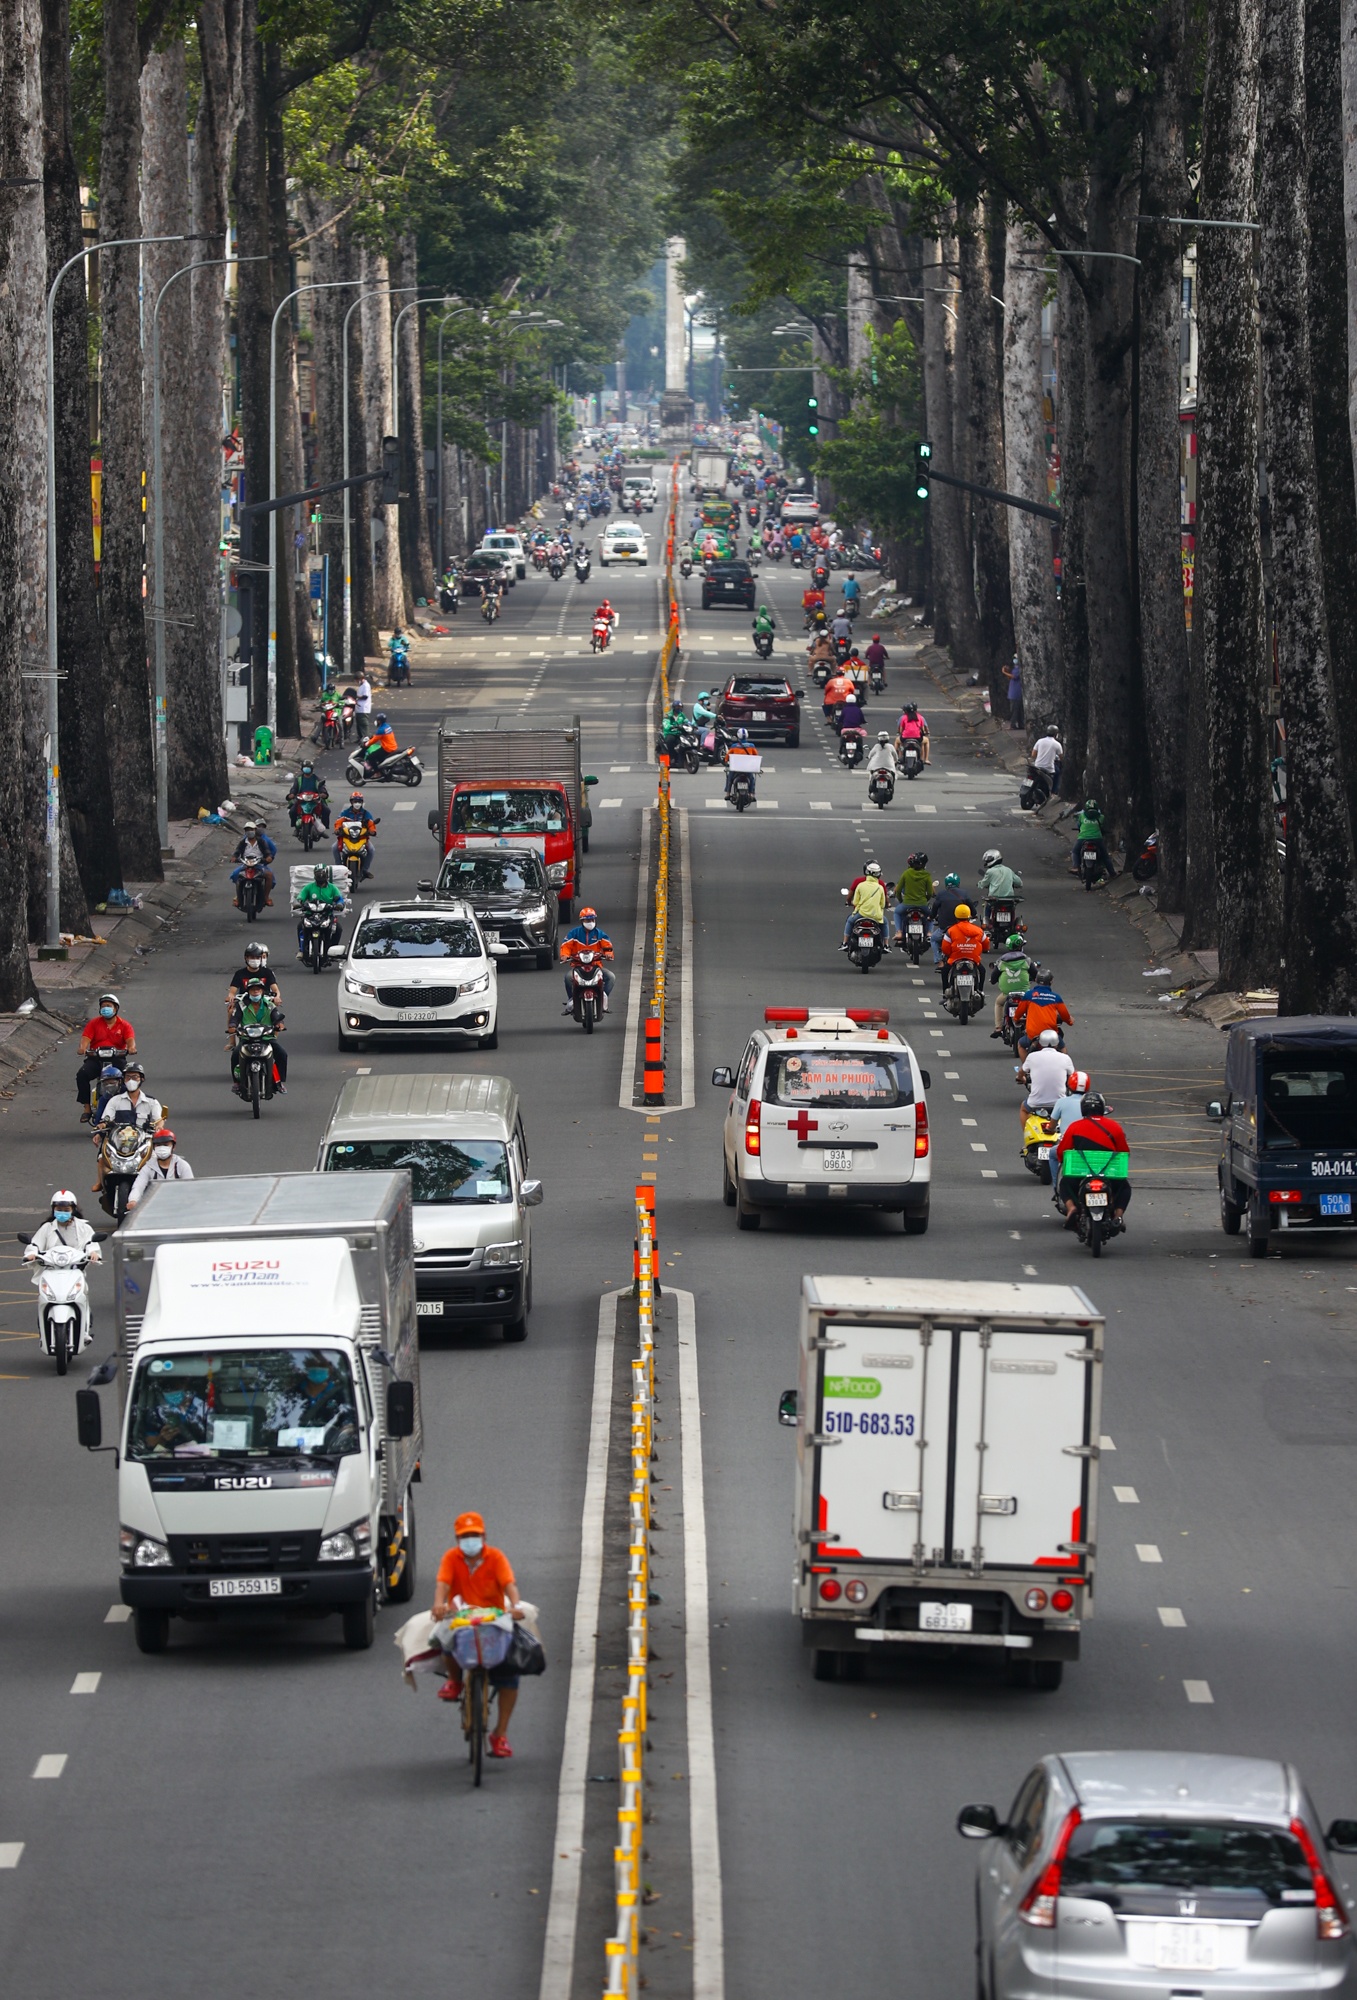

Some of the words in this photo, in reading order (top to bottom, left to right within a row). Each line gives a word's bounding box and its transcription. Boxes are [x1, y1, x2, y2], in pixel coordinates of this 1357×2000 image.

[825, 1073, 839, 1084] AN
[830, 1150, 846, 1160] 93A
[824, 1160, 852, 1169] 096.03
[1311, 1160, 1357, 1176] 50A-014.
[1326, 1195, 1344, 1204] 50A
[1321, 1203, 1350, 1214] 014.10
[212, 1260, 280, 1271] ISUZU
[825, 1411, 915, 1436] 51D-683.53
[214, 1476, 273, 1490] ISUZU
[211, 1579, 279, 1595] 51D-559.15
